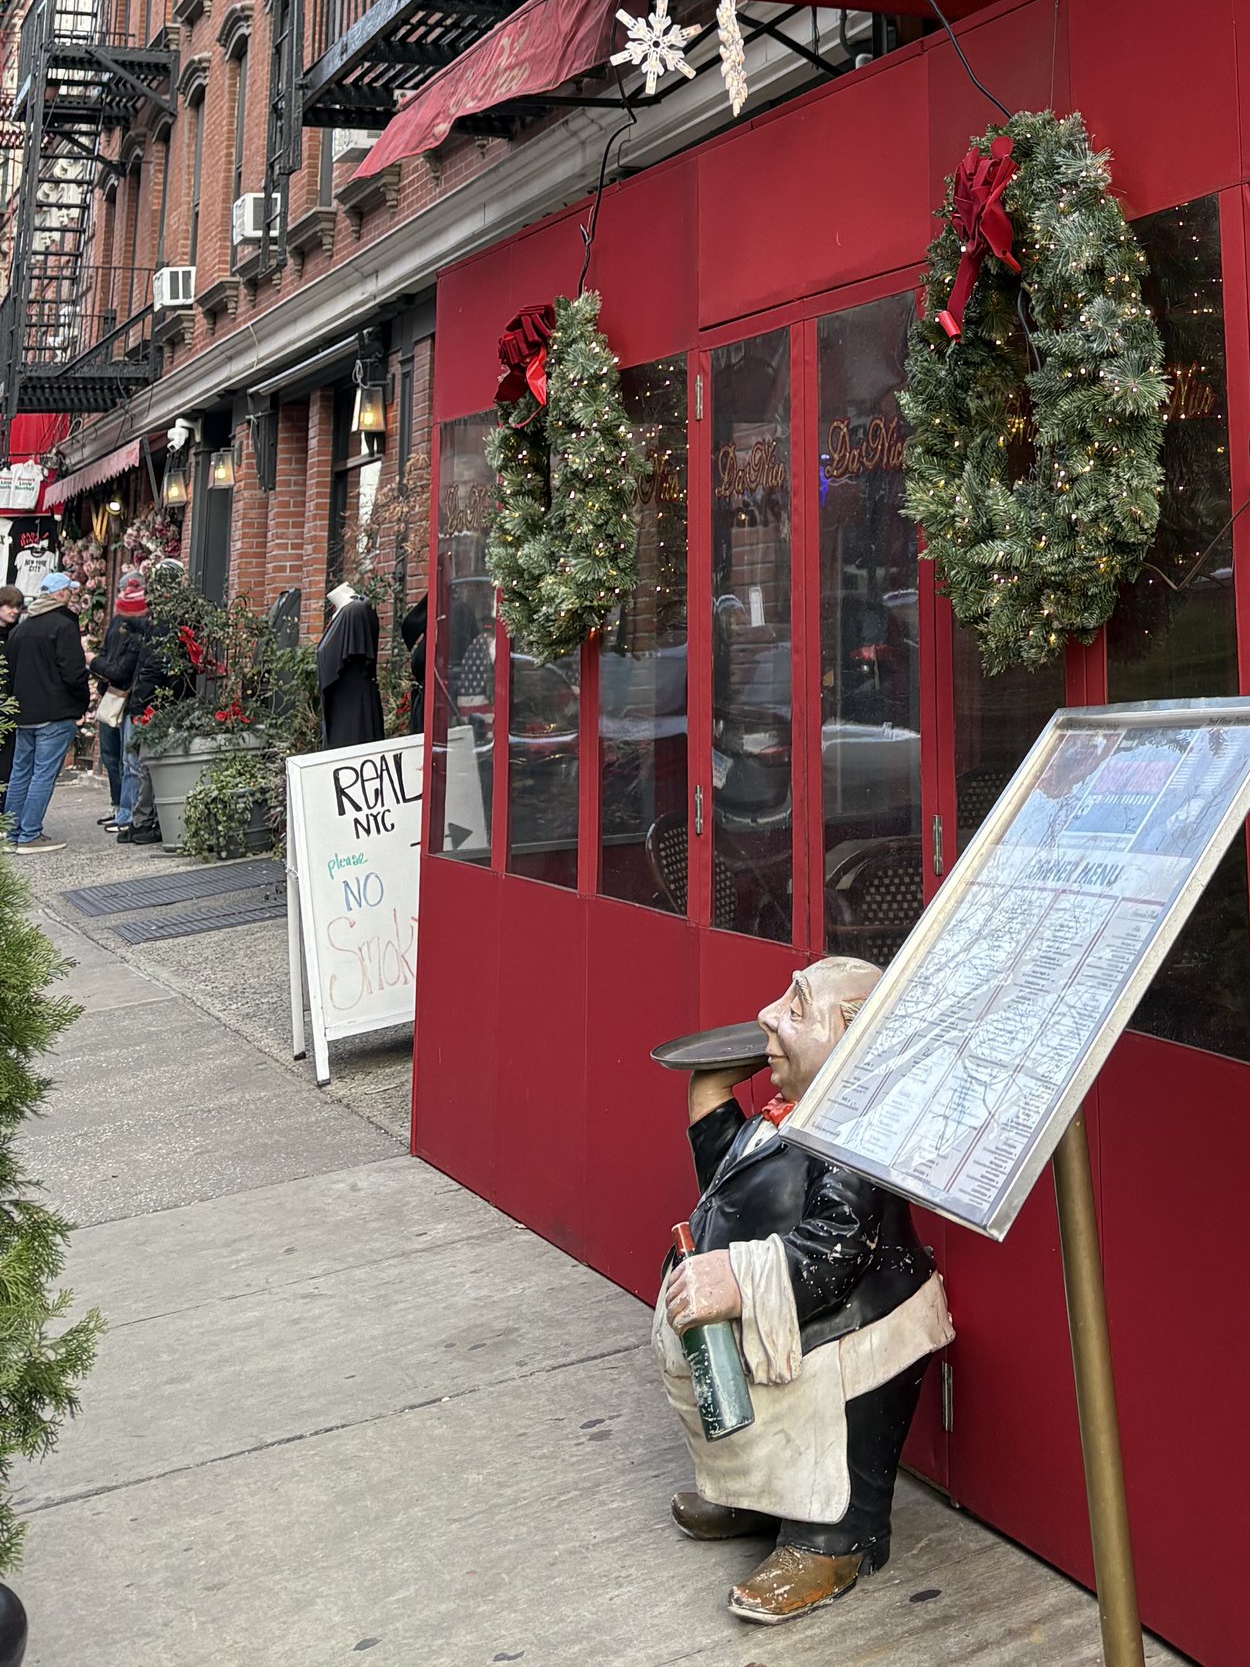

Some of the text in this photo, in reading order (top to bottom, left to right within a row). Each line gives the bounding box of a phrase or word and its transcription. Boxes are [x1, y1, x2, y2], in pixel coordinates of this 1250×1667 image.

[824, 415, 907, 479] Da Nic
[716, 442, 750, 498] Da
[353, 809, 395, 839] NYC
[328, 853, 368, 879] please
[1074, 861, 1126, 887] MENU
[343, 872, 384, 911] NO
[327, 908, 417, 1011] Smok
